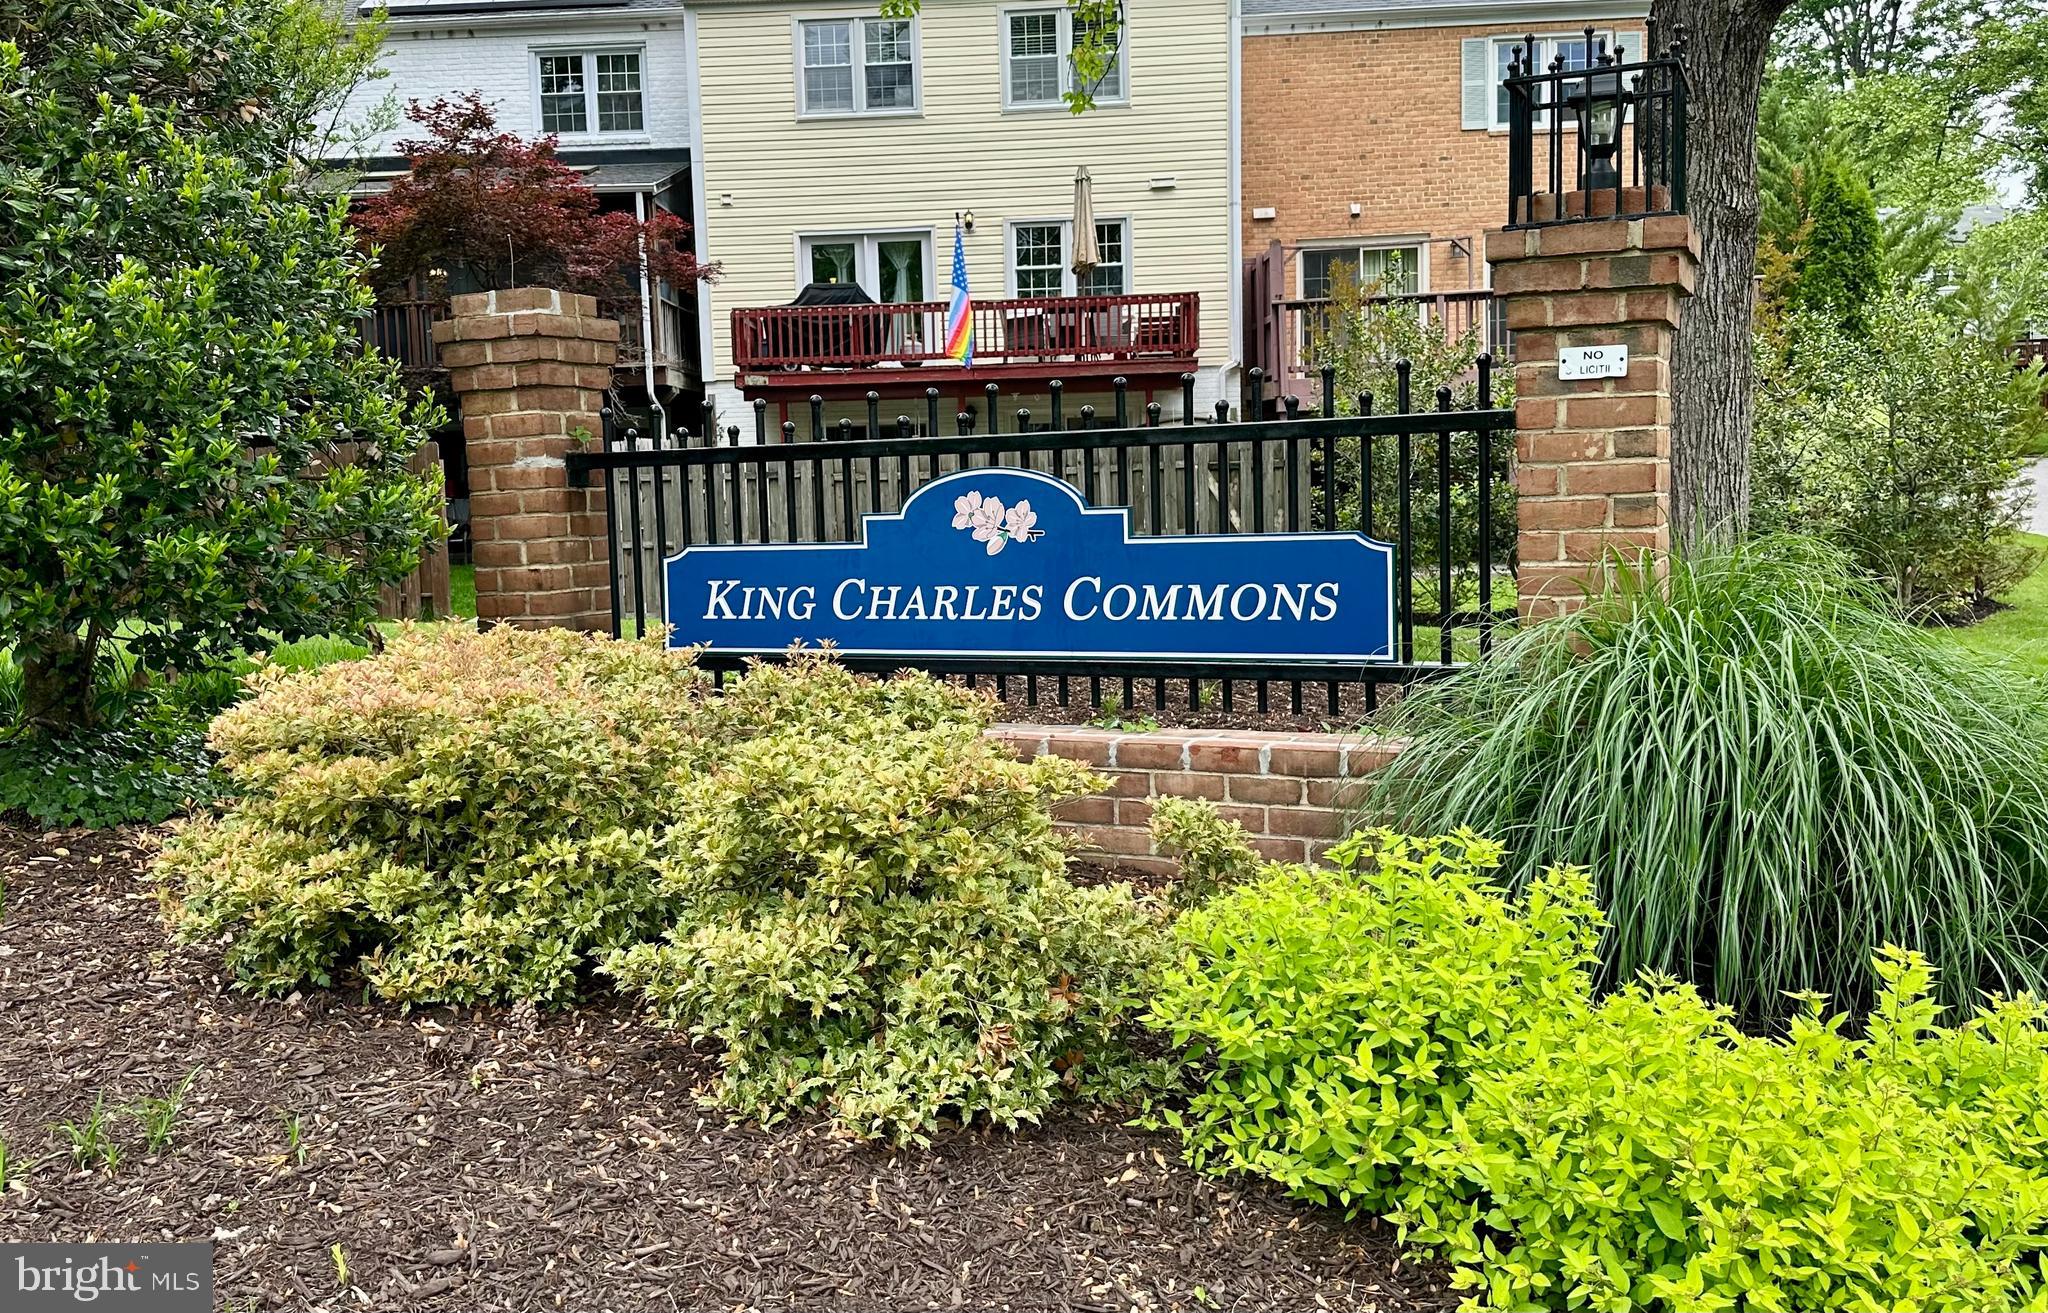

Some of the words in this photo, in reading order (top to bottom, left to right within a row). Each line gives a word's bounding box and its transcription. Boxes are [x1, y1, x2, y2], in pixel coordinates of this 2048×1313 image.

[1583, 350, 1604, 360] NO
[703, 579, 817, 620] KING
[832, 578, 1043, 621] CHARLES
[1063, 577, 1339, 621] COMMONS
